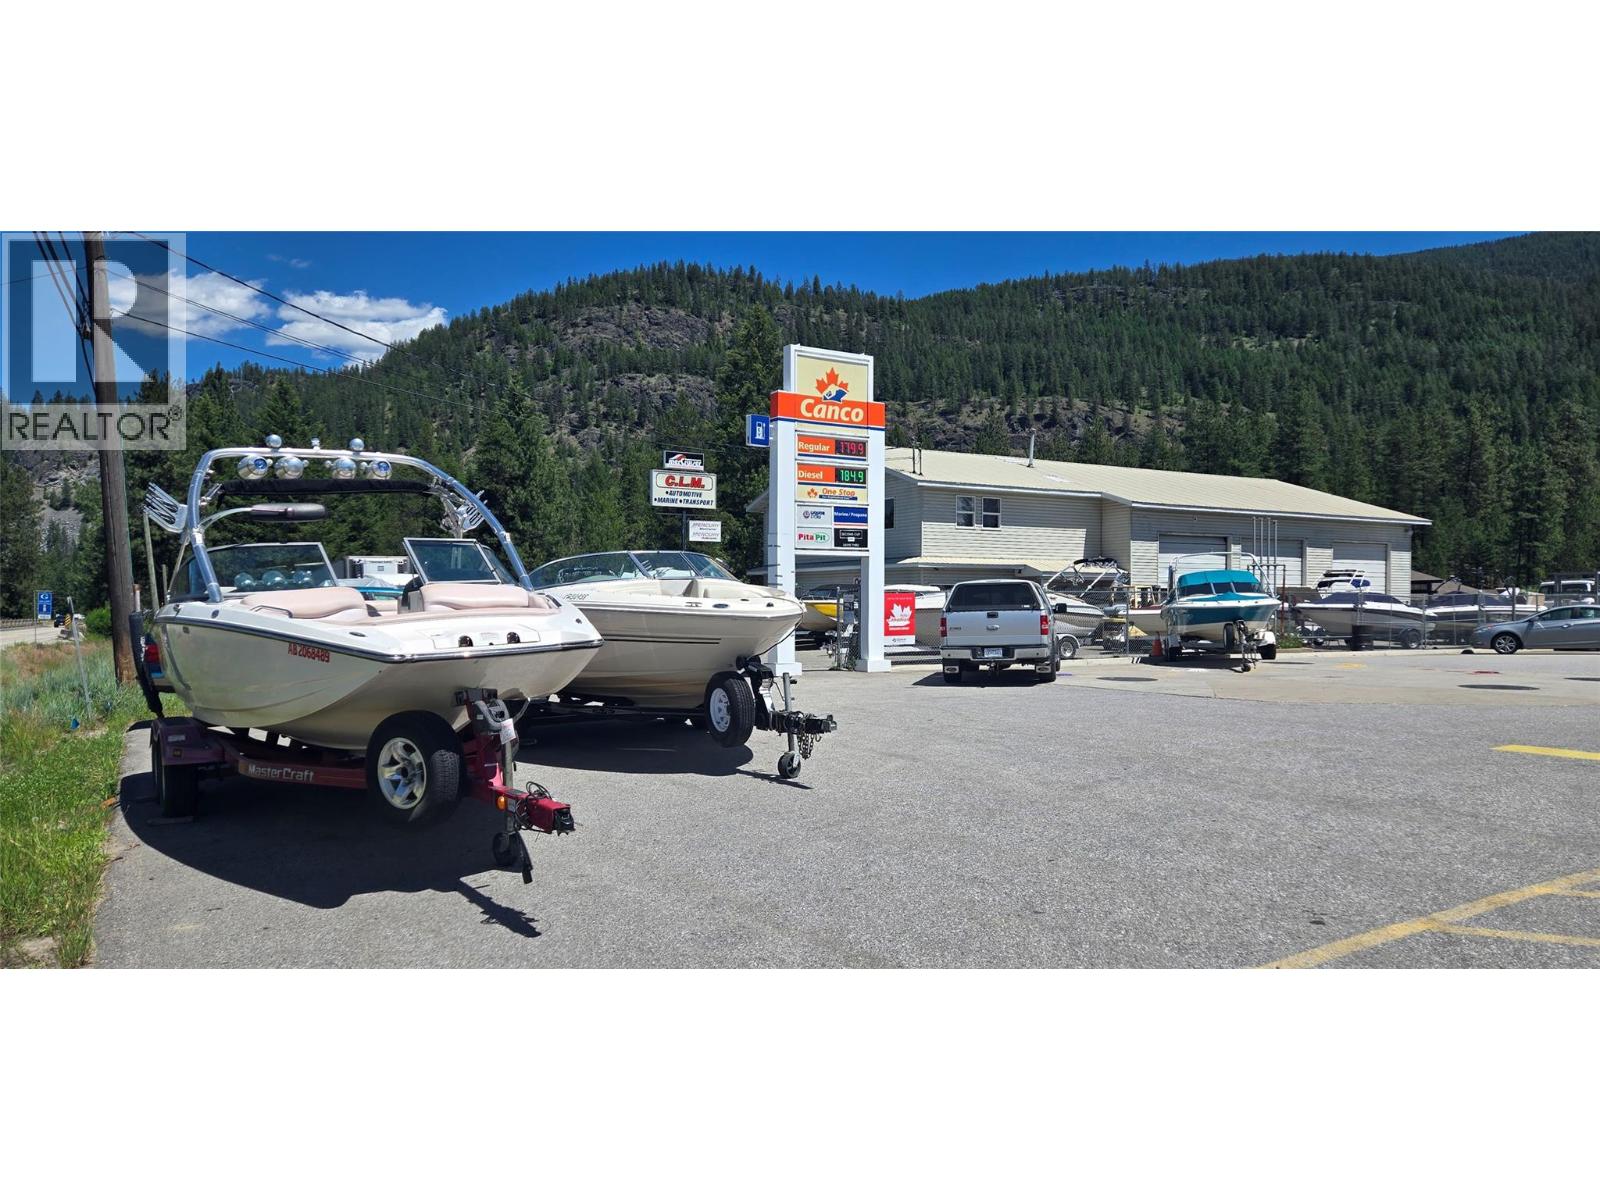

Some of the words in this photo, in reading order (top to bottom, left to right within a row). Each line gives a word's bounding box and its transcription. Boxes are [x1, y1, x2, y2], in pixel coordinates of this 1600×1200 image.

[800, 398, 864, 423] Canco
[798, 441, 830, 452] Regular
[798, 470, 823, 480] Diesel
[665, 474, 705, 489] C.L.M.
[669, 490, 702, 498] AUTOMOTIVE
[822, 487, 837, 495] One
[838, 488, 856, 497] Stop
[682, 498, 714, 506] TRANSPORT
[798, 533, 814, 541] Pita
[287, 641, 297, 656] AB
[248, 763, 314, 782] MasterCraft
